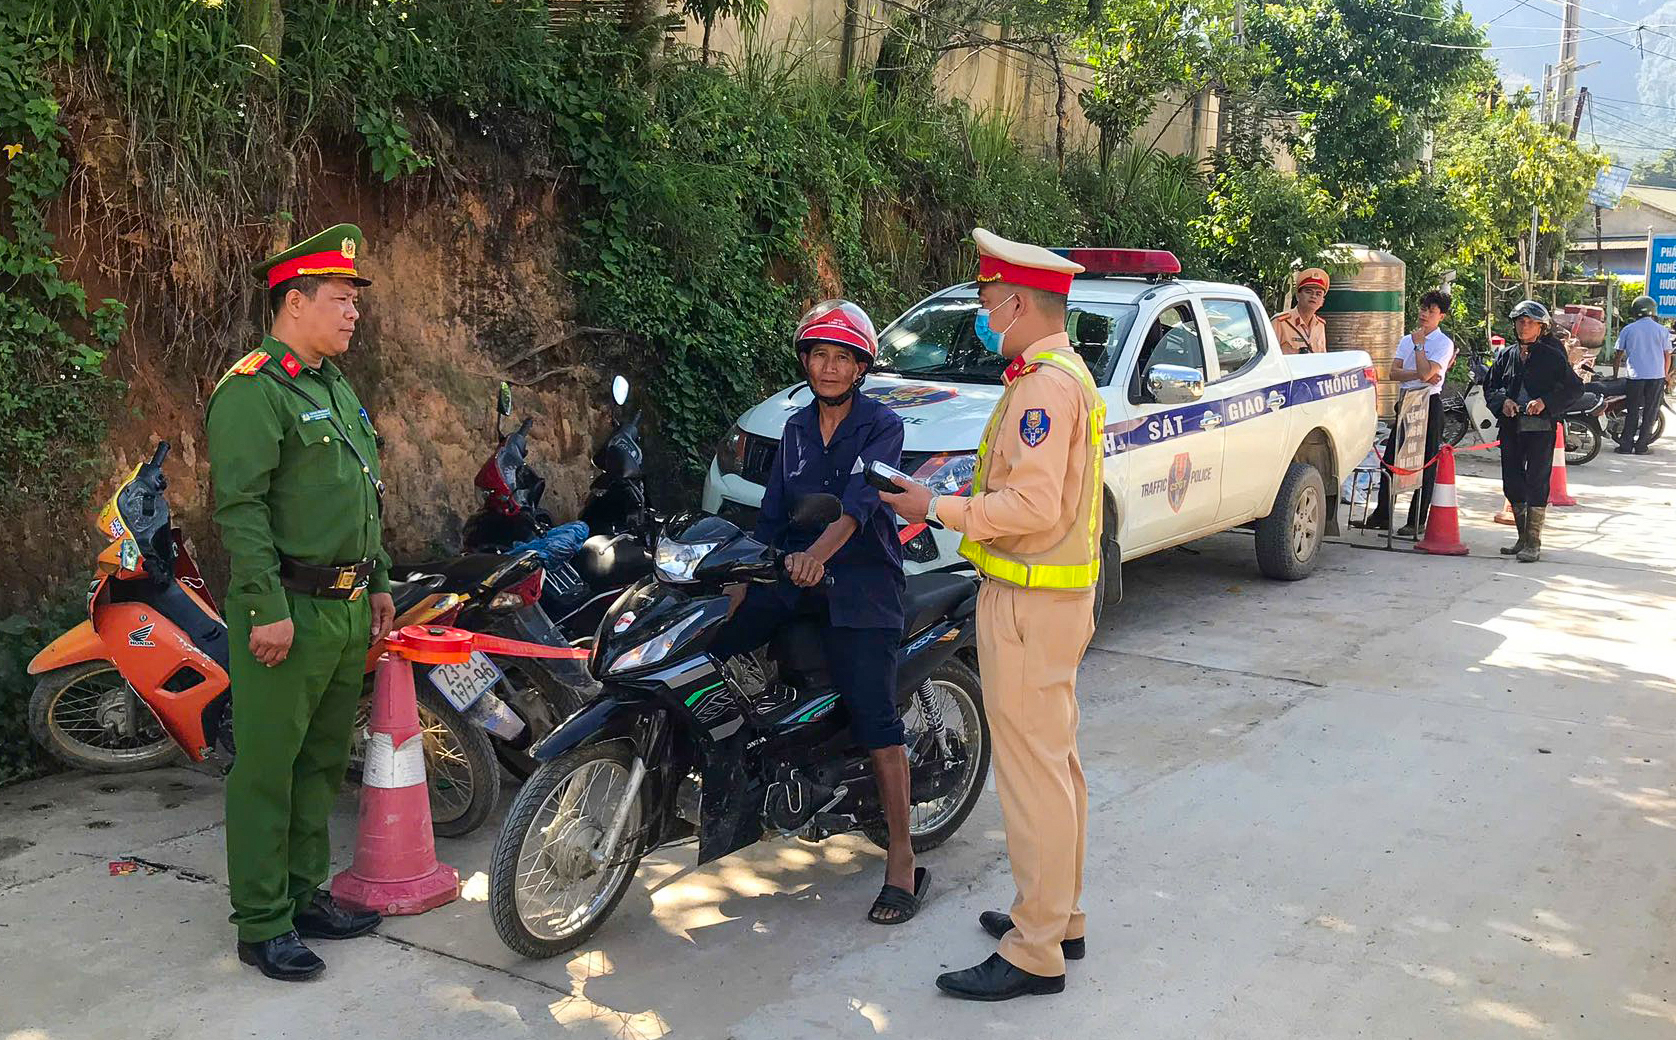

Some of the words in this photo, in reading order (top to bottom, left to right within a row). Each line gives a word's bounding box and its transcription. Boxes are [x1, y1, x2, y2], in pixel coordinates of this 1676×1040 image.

[1148, 413, 1184, 441] SÁT
[1228, 395, 1265, 421] GIAO
[1317, 373, 1360, 397] THÔNG
[1141, 477, 1168, 498] TRAFFIC
[1190, 467, 1213, 484] POLICE
